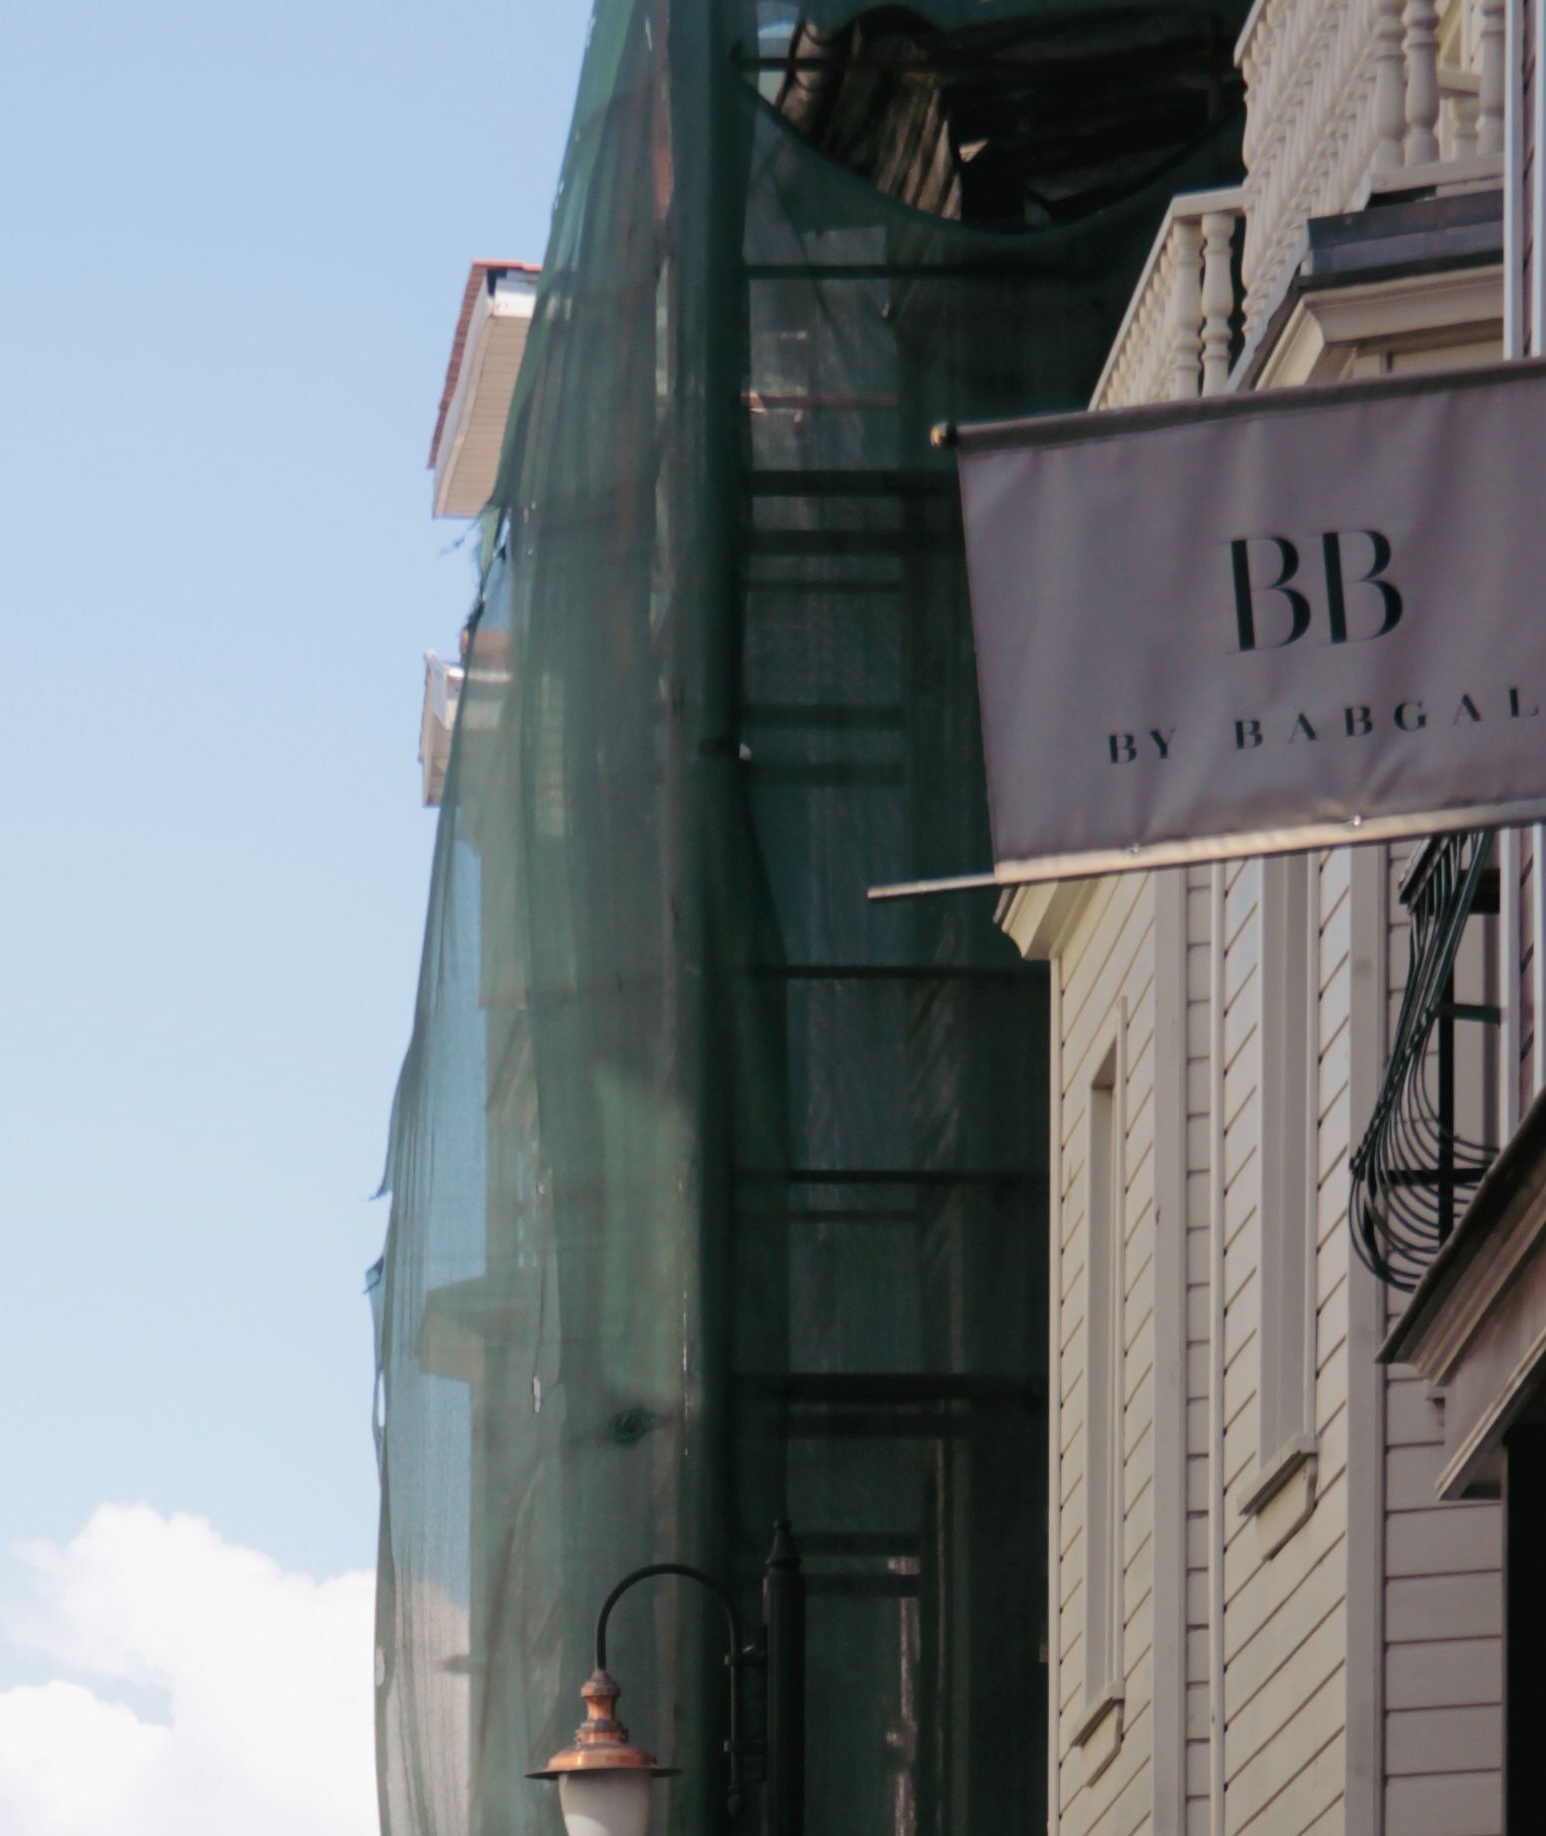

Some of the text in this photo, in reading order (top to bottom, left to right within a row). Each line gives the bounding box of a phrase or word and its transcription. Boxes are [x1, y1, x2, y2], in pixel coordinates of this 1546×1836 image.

[1227, 528, 1404, 654] BB
[1107, 686, 1540, 765] BY BABGAL
